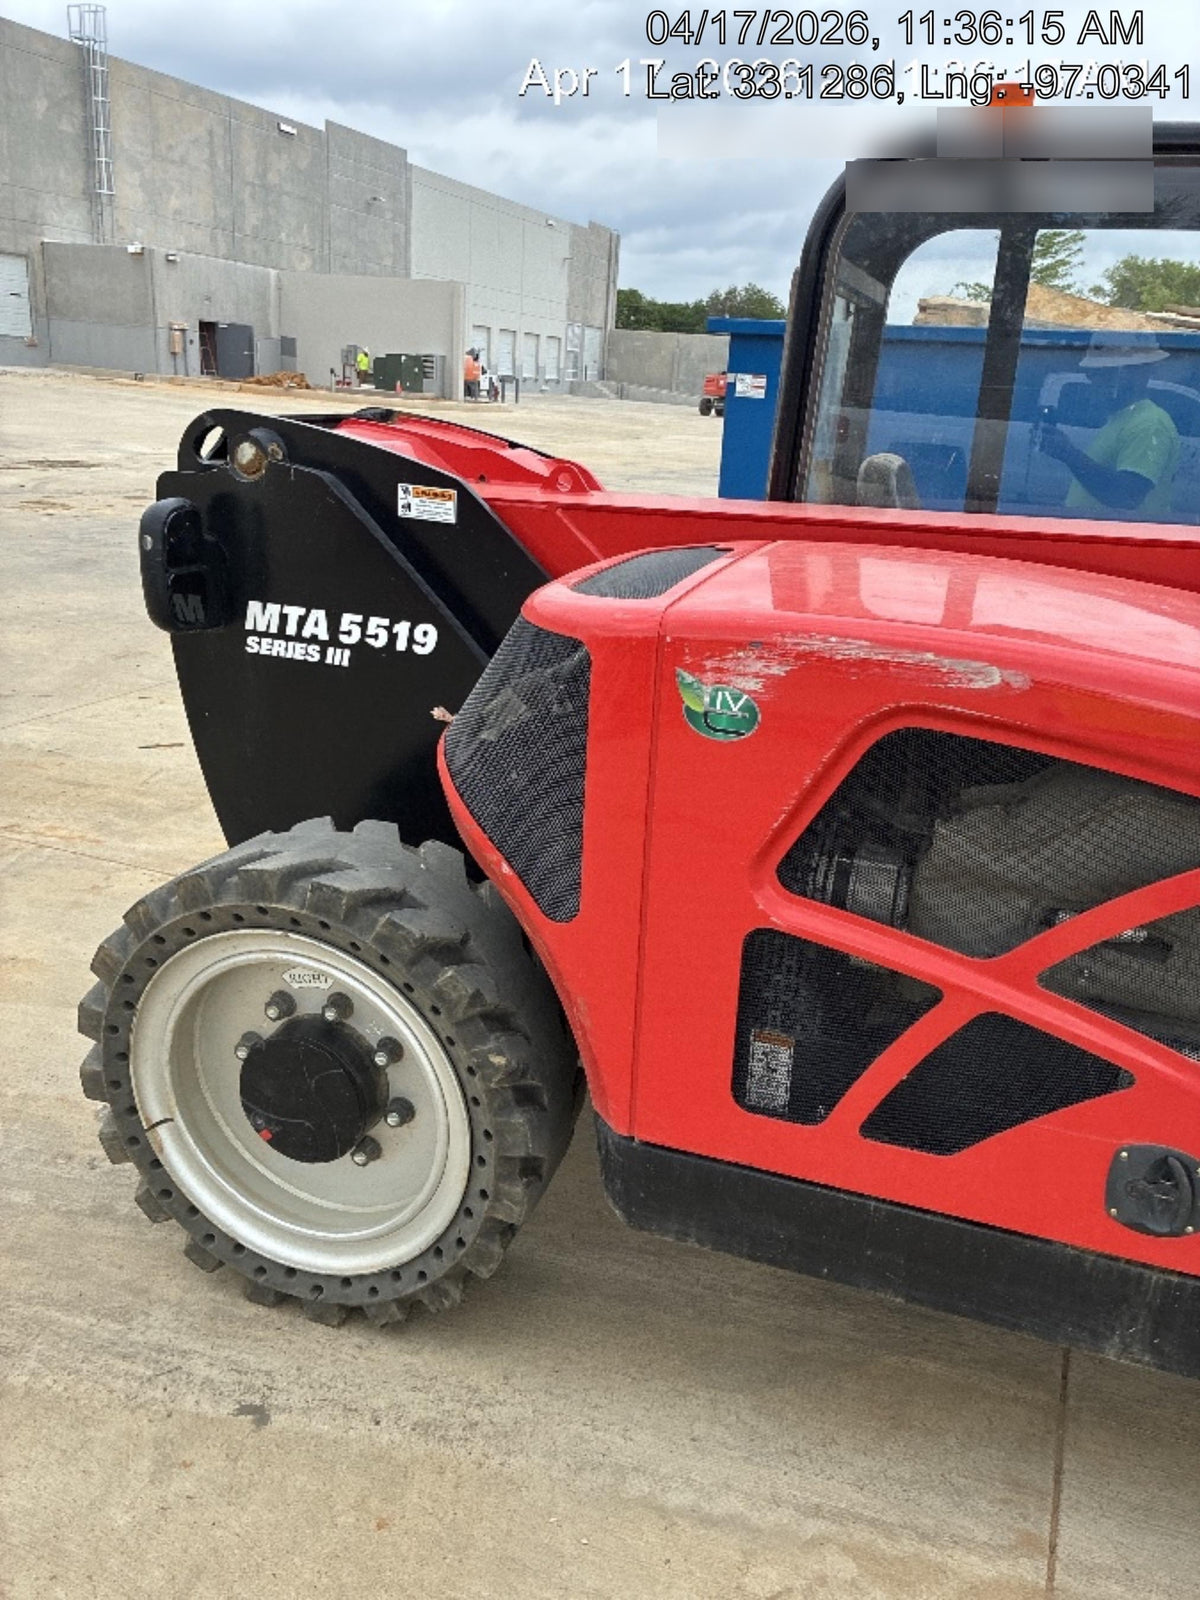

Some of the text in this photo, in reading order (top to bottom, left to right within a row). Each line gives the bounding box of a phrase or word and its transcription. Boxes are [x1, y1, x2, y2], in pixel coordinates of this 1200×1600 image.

[172, 593, 204, 626] M
[245, 601, 438, 655] MTA 5519
[245, 636, 351, 667] SERIES III
